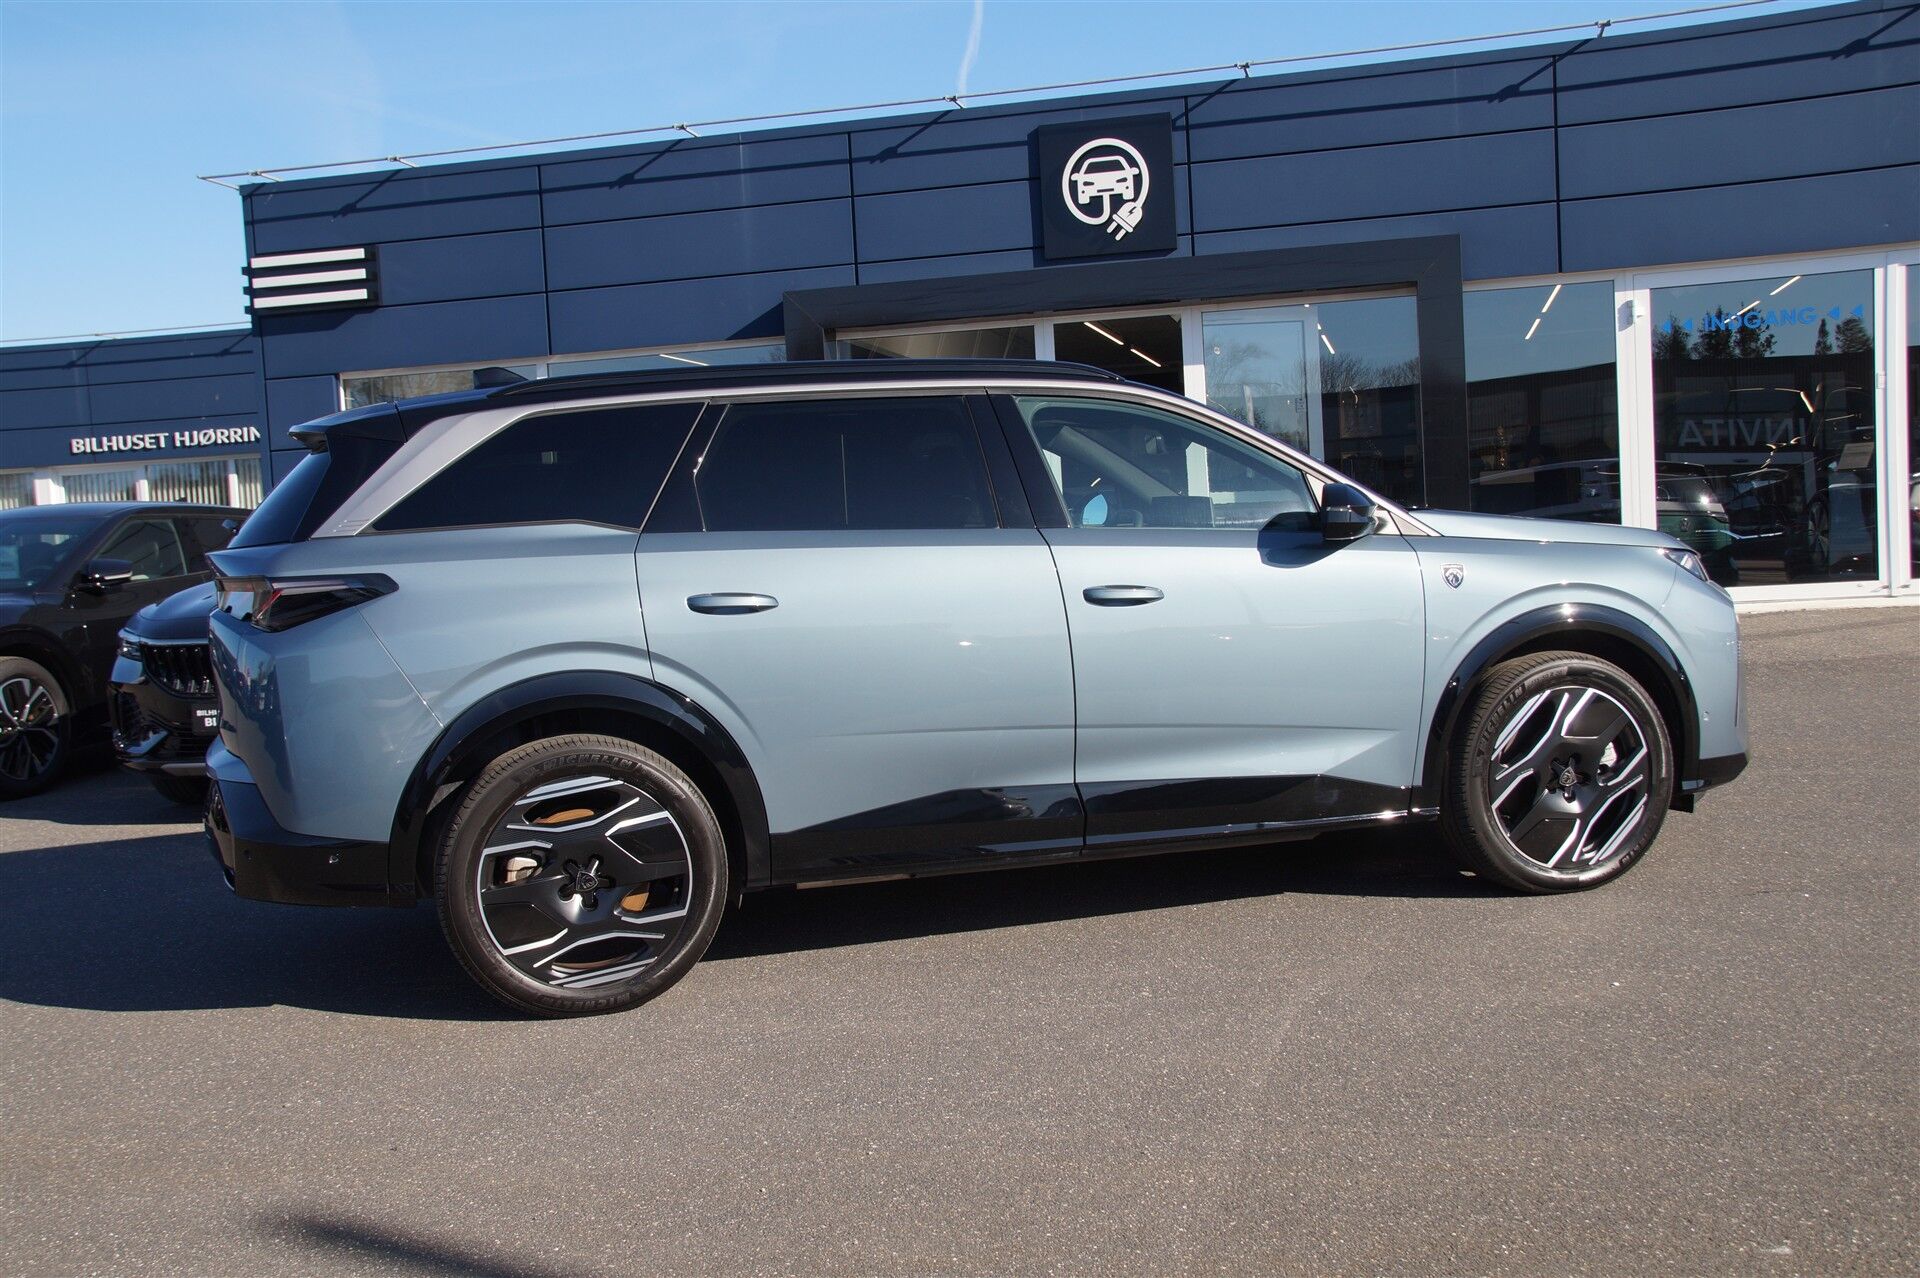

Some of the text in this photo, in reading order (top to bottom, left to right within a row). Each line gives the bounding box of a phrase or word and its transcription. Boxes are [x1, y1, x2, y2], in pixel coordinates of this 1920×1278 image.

[1704, 305, 1817, 332] INDGANG
[70, 432, 170, 455] BILHUSET
[543, 753, 633, 771] MICHELIN
